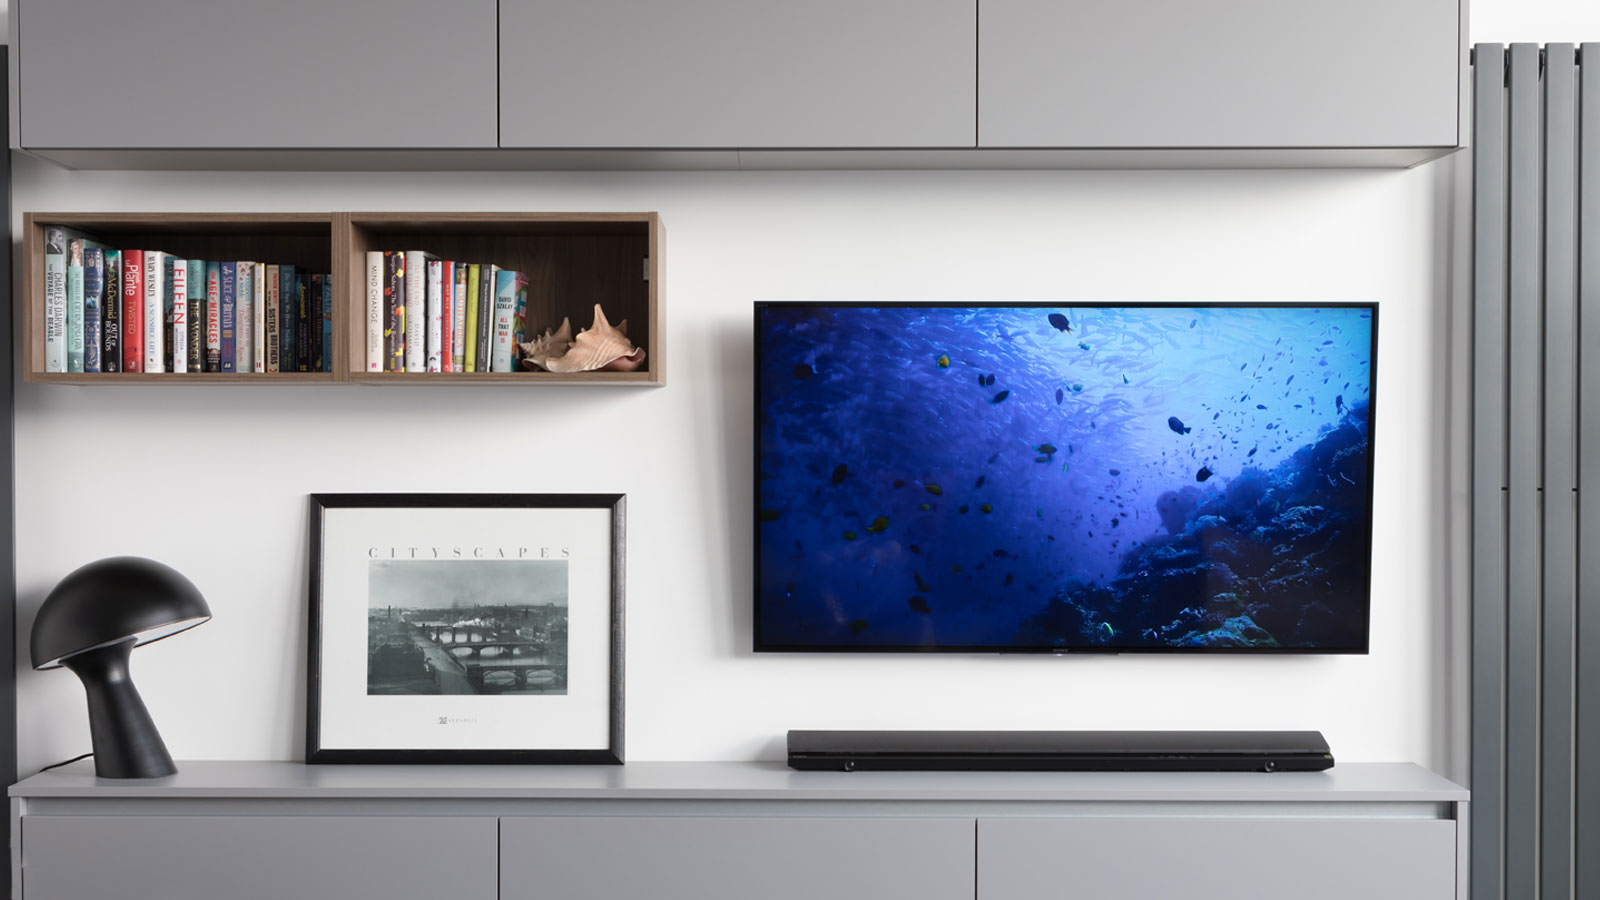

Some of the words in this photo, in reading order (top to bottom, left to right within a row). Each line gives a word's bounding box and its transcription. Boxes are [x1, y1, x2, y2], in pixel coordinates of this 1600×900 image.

[148, 256, 156, 273] MARY
[414, 264, 420, 273] TO
[54, 272, 63, 305] CHARLES
[125, 265, 139, 296] Plante
[148, 274, 156, 297] WESLEY
[209, 280, 218, 297] AGE
[173, 269, 186, 326] EILEEN
[190, 301, 199, 318] THE
[496, 302, 513, 310] SZALAY
[54, 307, 63, 337] DARWIN
[128, 300, 136, 334] TWISTED
[208, 302, 218, 344] MIRACLES
[268, 308, 276, 333] SISTERS
[190, 321, 200, 360] WONDER
[456, 318, 465, 349] AFRICA
[270, 334, 278, 364] BROTHERS
[368, 547, 570, 559] CITYSCAPES
